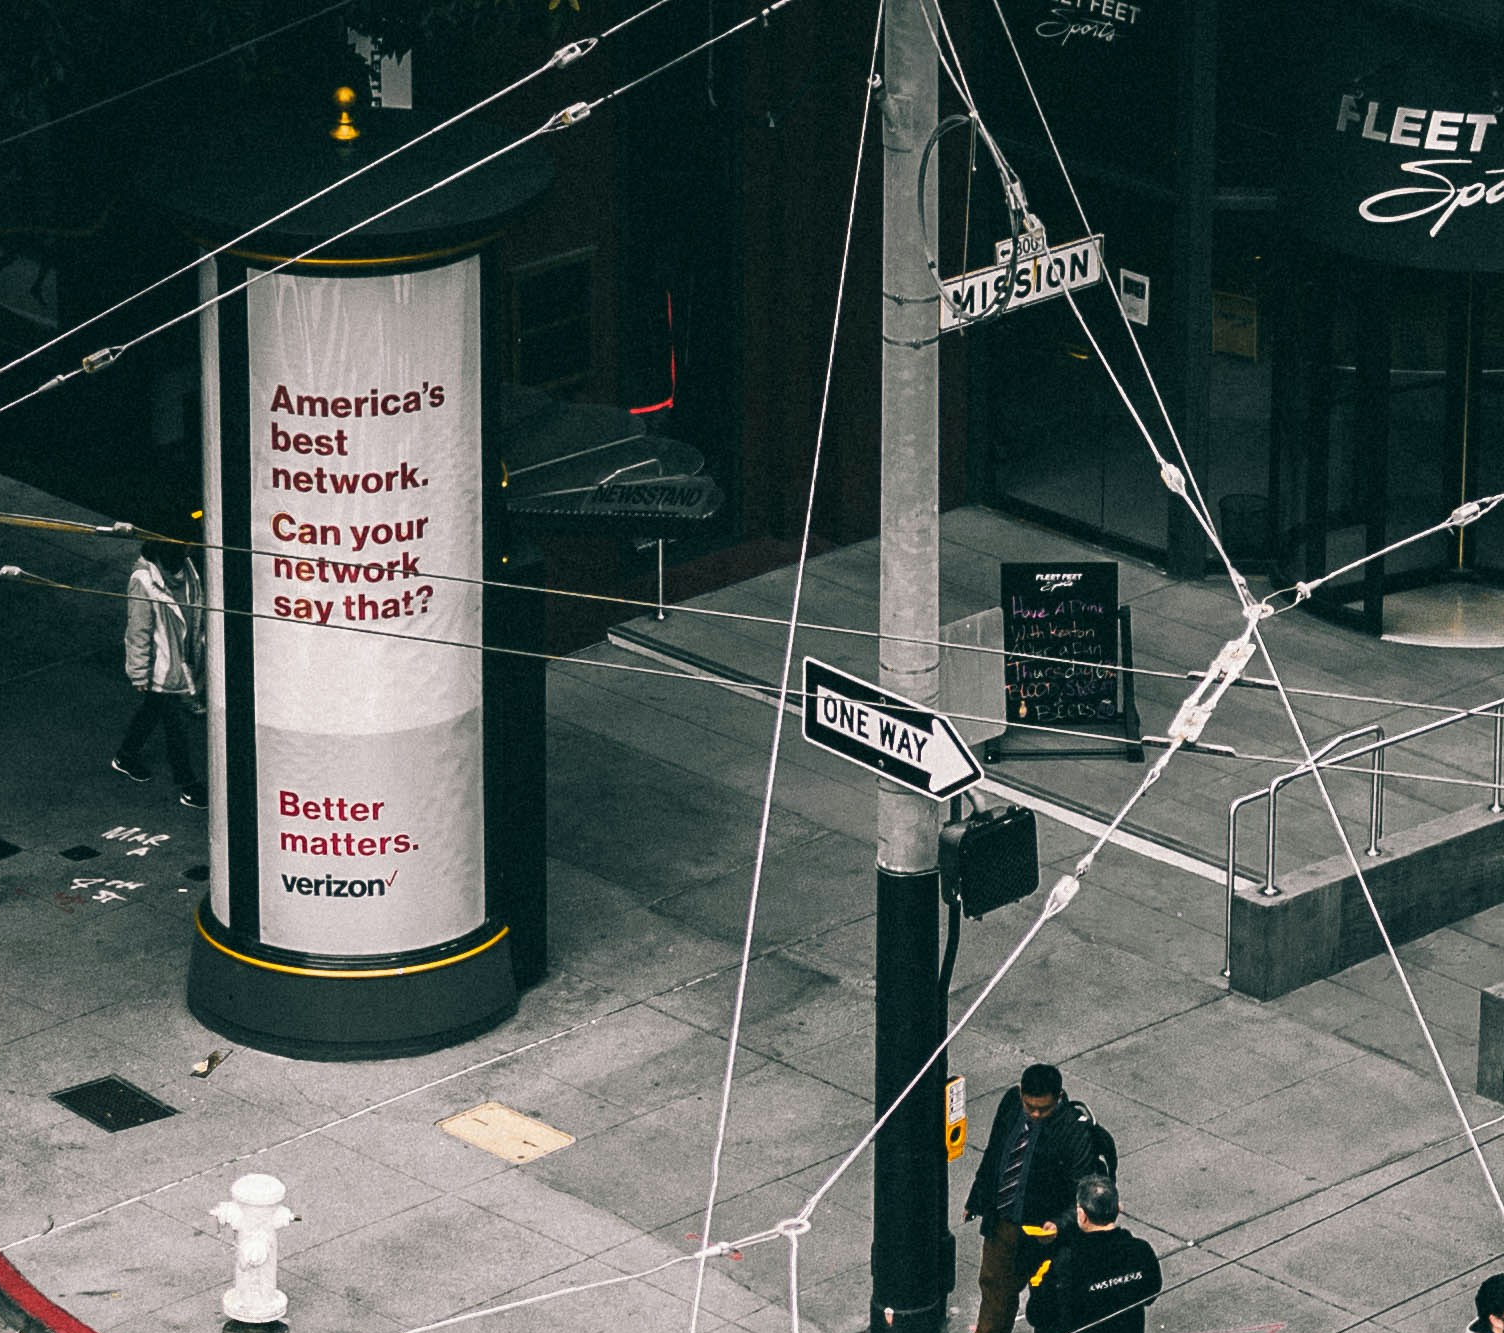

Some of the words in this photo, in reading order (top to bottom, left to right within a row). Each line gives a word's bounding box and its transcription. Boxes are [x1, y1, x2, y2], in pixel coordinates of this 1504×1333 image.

[1335, 93, 1498, 153] FLEET
[952, 248, 1090, 318] MISSION
[269, 381, 445, 418] America's
[271, 422, 348, 456] best
[272, 461, 429, 494] network.
[593, 484, 704, 508] NEWSSTAND
[271, 512, 341, 546] Can
[350, 516, 429, 551] your
[273, 551, 420, 584] network
[273, 595, 334, 624] say
[343, 585, 434, 621] that?
[1011, 595, 1049, 619] Have
[1054, 601, 1065, 615] A
[823, 695, 870, 739] ONE
[879, 717, 927, 763] WAY
[279, 790, 385, 822] Better
[280, 832, 419, 857] matters.
[281, 873, 385, 898] verizon
